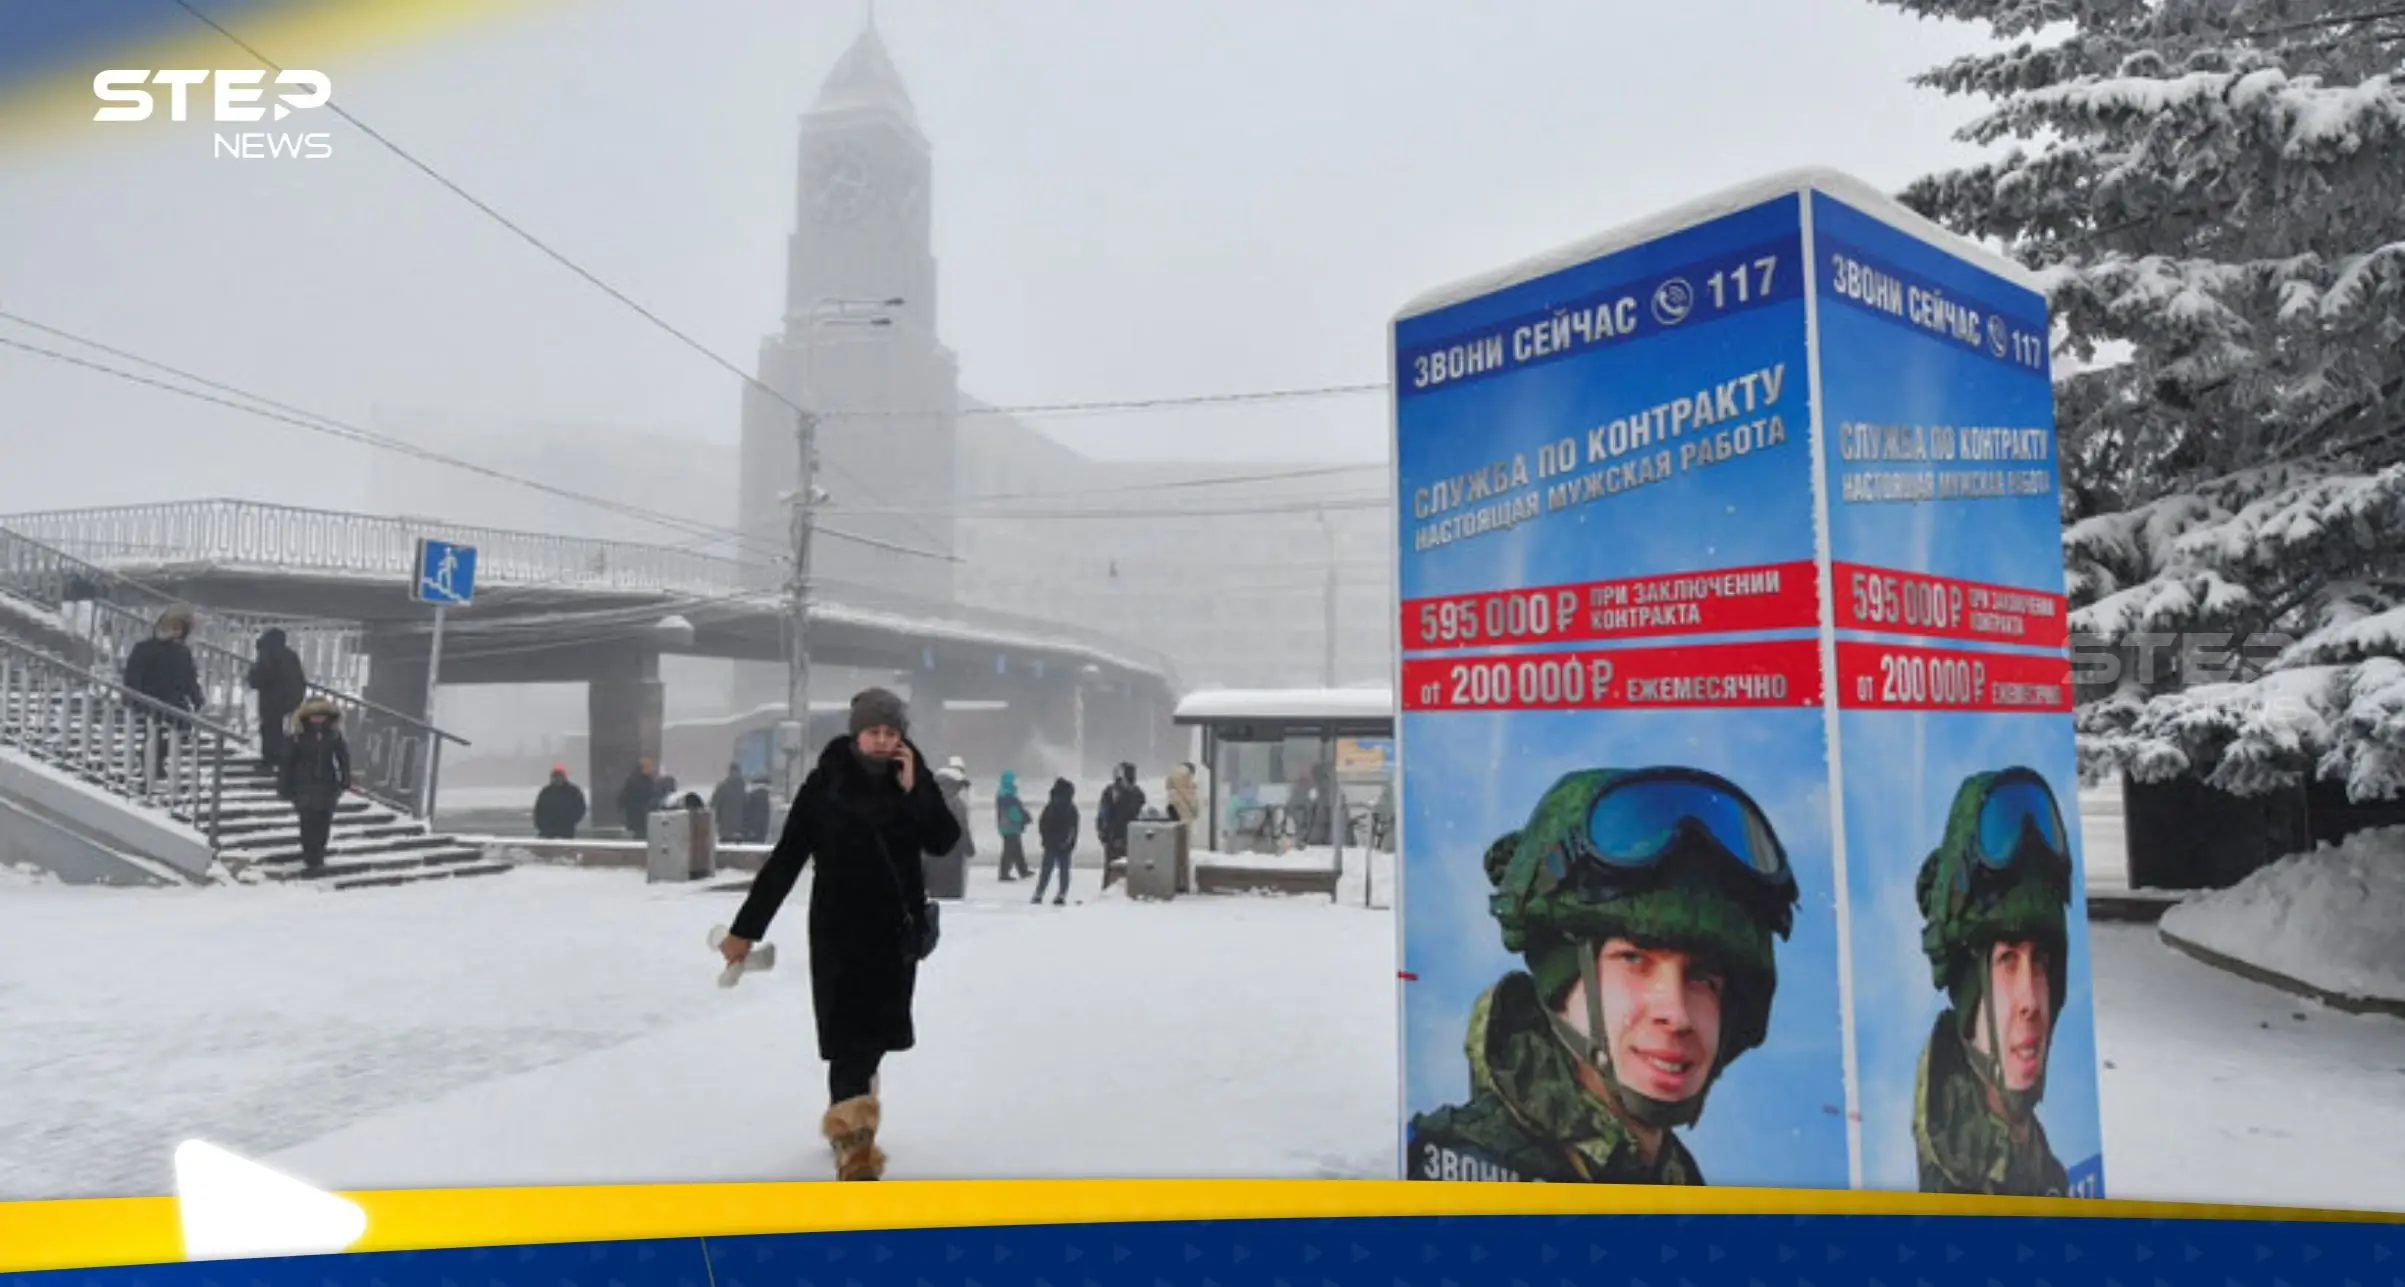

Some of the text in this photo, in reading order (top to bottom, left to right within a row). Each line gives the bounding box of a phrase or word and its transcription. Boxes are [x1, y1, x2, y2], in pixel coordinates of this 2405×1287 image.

[1414, 256, 1778, 389] ЗВОНИ СЕЙЧАС 117
[1831, 253, 2041, 370] ЗВОНИ СЕЙЧАС 117
[1413, 362, 1786, 520] СЛУЖБА ПО КОНТРАКТУ
[1414, 415, 1787, 552] НАСТОЯЩАЯ МУЖСКАЯ РАБОТА
[1590, 569, 1781, 609] ПРИ ЗАКЛЮЧЕНИИ
[1852, 573, 1900, 624] 595
[1903, 581, 1947, 628] 000
[1419, 599, 1478, 642] 595
[1484, 593, 1551, 637] 000
[1590, 605, 1701, 630] КОНТРАКТА
[1450, 663, 1511, 705] 200
[1517, 658, 1585, 704] 000
[1627, 674, 1788, 701] ЕЖЕМЕСЯЧНО
[1880, 654, 1927, 703] 200
[1929, 658, 1971, 705] 000
